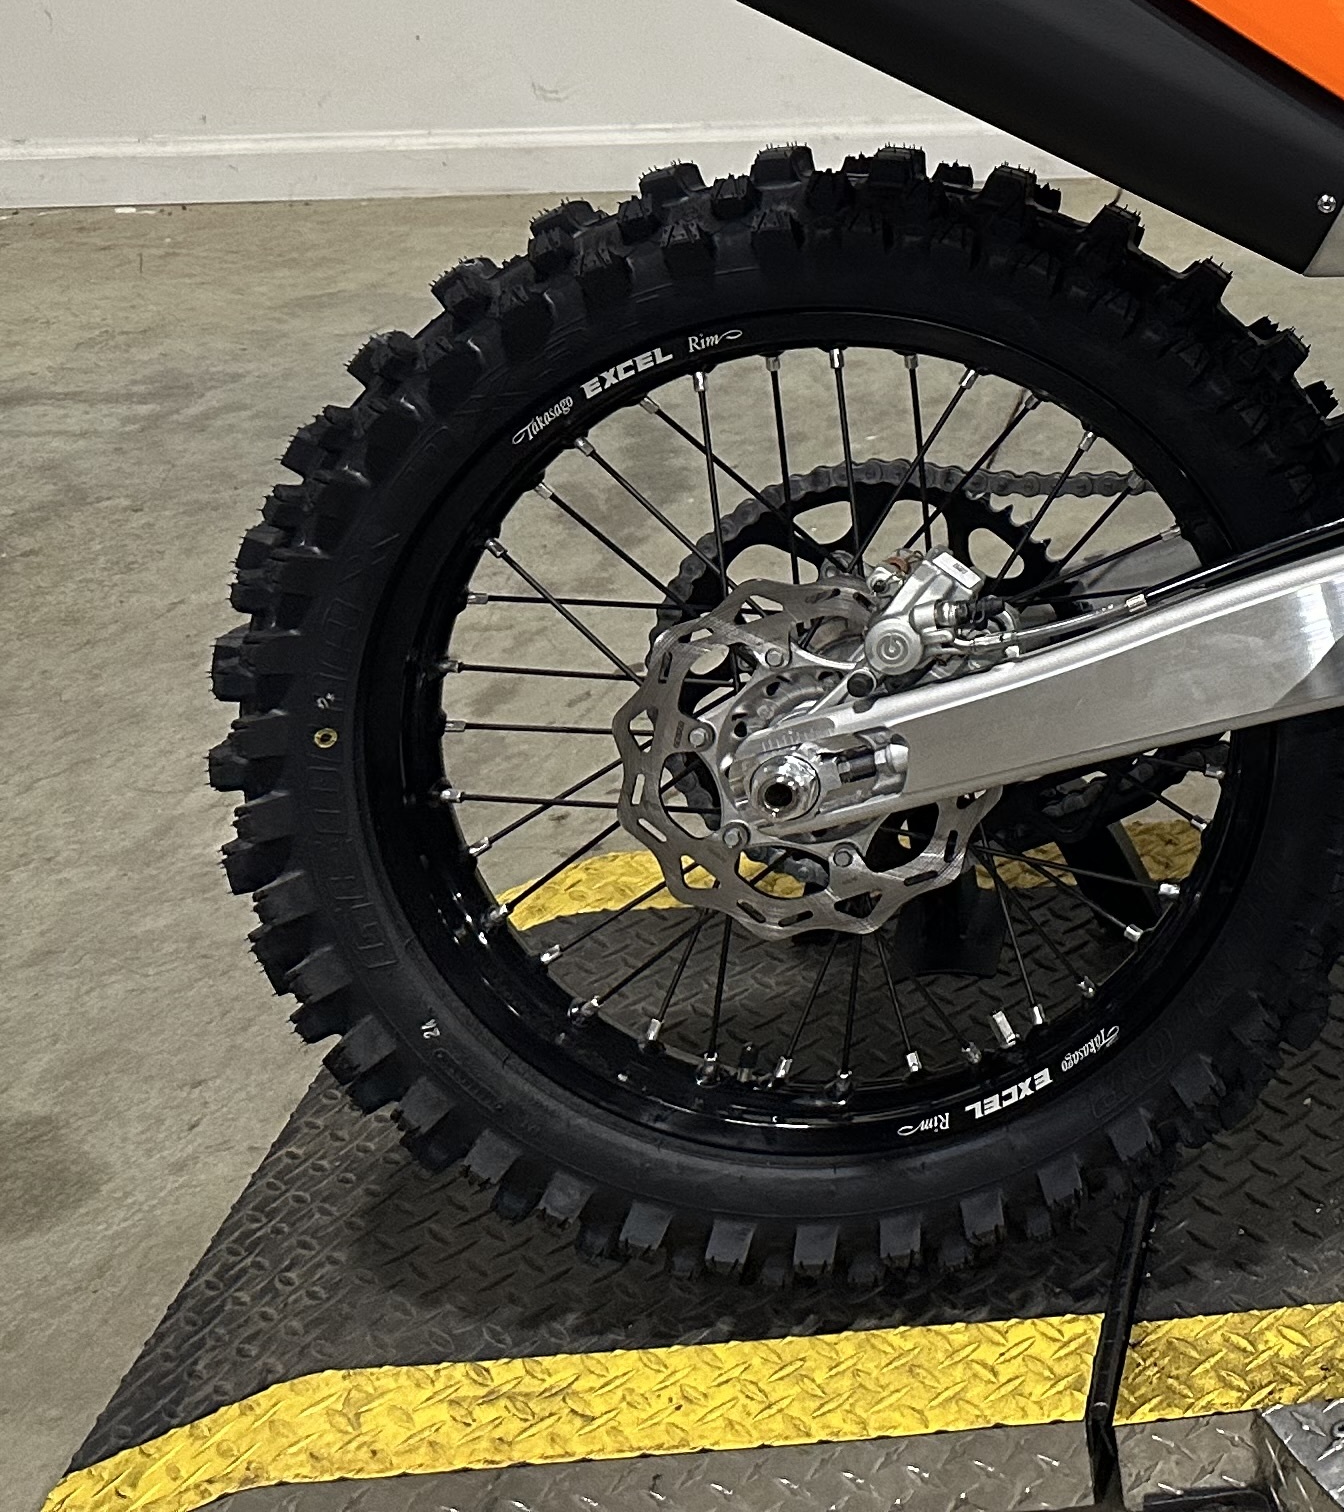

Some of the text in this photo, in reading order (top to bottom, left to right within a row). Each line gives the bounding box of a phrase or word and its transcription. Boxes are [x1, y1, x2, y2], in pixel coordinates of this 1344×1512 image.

[511, 329, 743, 445] Takasago EXCEL Rim
[897, 1025, 1119, 1136] Takasago EXCEL Rim
